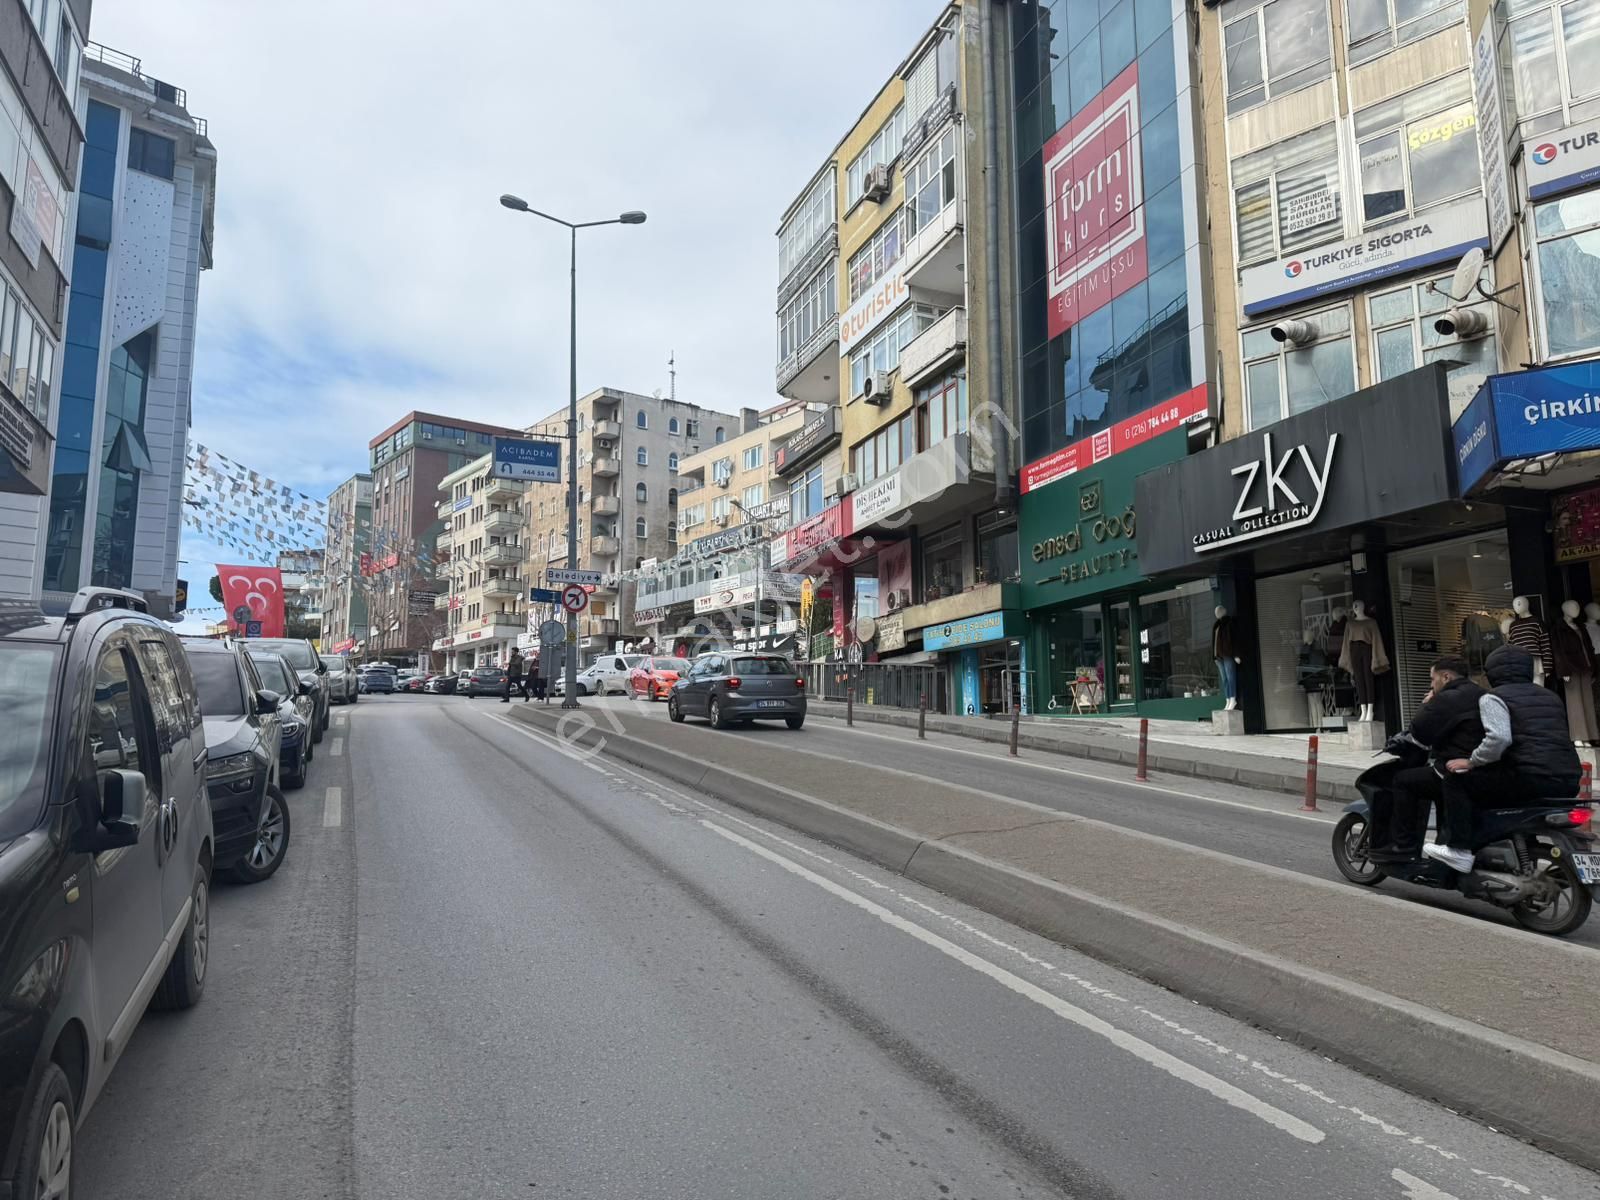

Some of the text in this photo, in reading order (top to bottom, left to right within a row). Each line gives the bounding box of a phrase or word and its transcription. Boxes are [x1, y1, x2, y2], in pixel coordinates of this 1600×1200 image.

[1061, 149, 1122, 221] form
[1290, 195, 1332, 214] SATILIK
[1065, 193, 1123, 253] kurs
[1058, 248, 1135, 314] EĞİTİM ÜSSÜ
[1131, 423, 1147, 438] (216)
[1148, 415, 1159, 428] 784
[501, 446, 553, 458] ACIBADEM
[868, 476, 896, 503] HEKİMİ
[1231, 432, 1338, 523] zky
[1032, 522, 1081, 563] emsal
[1192, 526, 1232, 545] CASUAL
[548, 570, 592, 582] Belediye
[1060, 548, 1128, 582] BEAUTY
[700, 597, 711, 606] THY
[1574, 855, 1586, 866] 34
